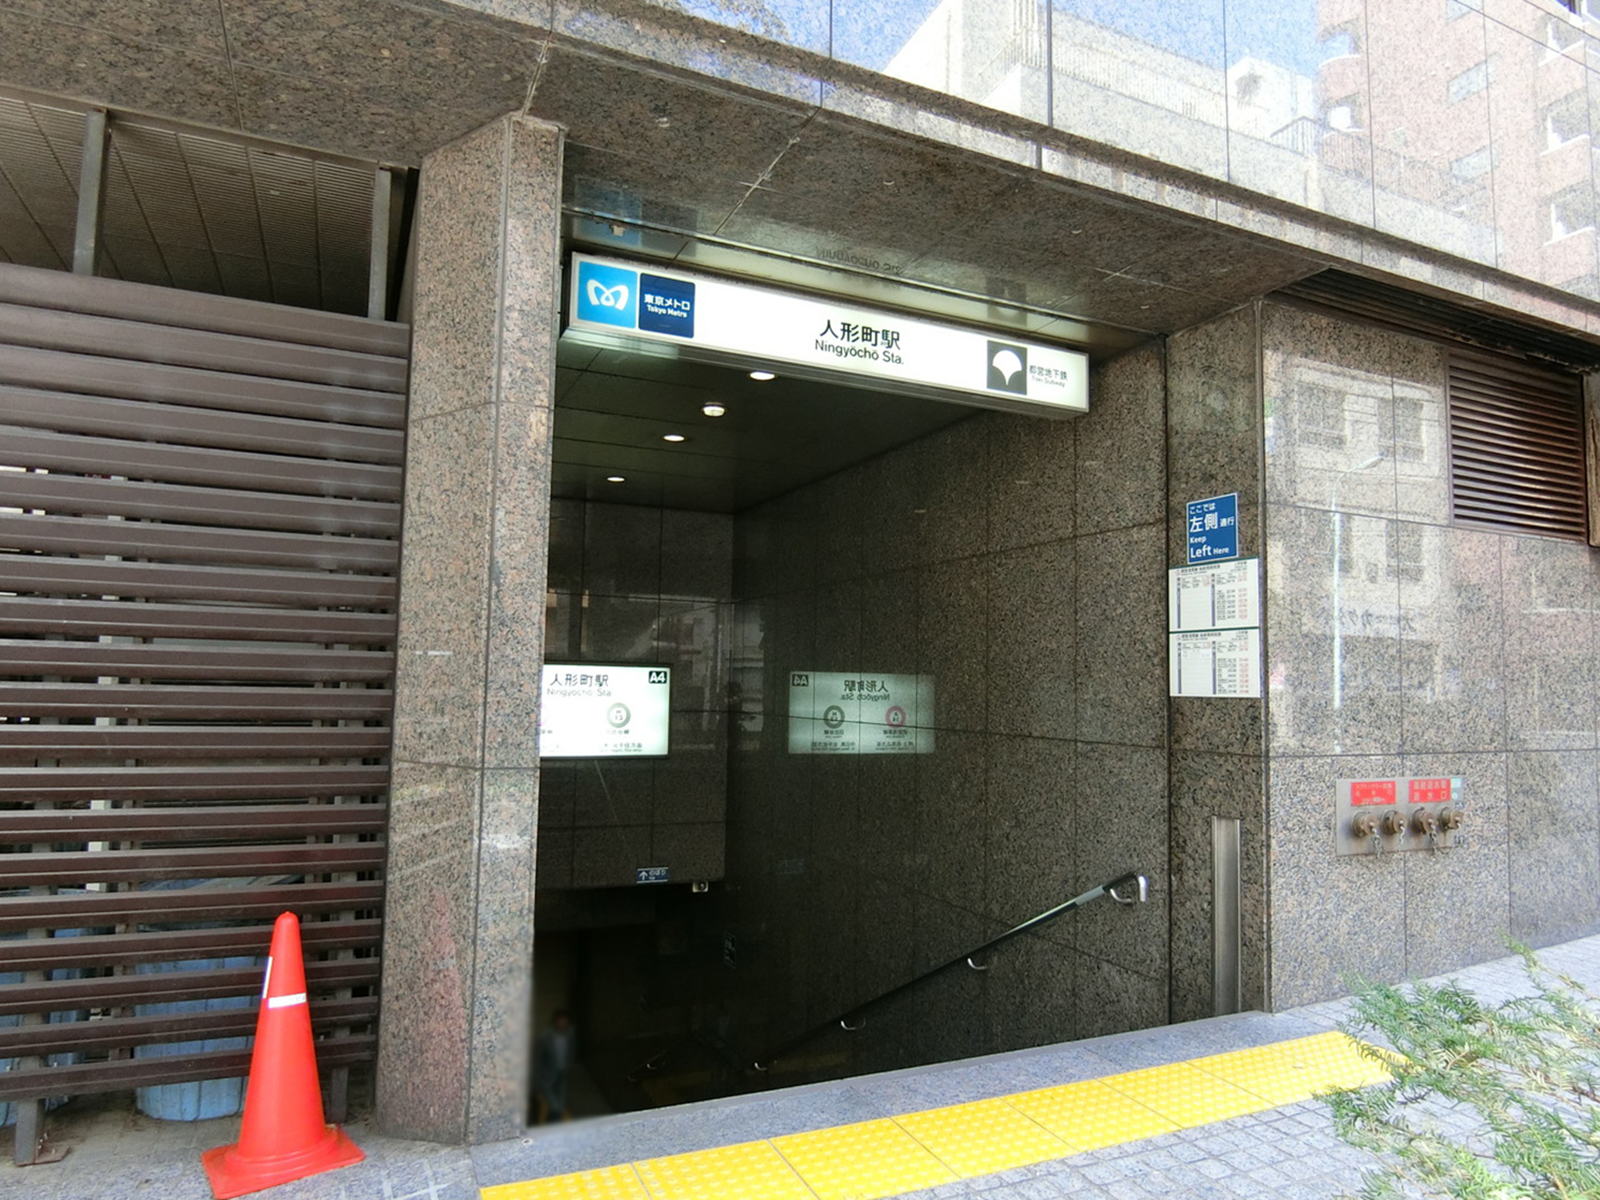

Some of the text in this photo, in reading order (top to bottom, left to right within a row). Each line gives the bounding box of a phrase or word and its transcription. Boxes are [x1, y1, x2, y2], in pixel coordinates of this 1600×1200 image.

[644, 293, 691, 311] 東京メトロ
[647, 304, 688, 318] Tokyo Metro
[819, 318, 901, 351] 人形町駅
[815, 339, 905, 365] Ningyōchō Sta.
[1029, 364, 1068, 381] 都営地下鉄
[1190, 502, 1216, 515] ここでは
[1190, 536, 1207, 544] Keep
[1190, 544, 1230, 558] Left Here
[549, 673, 609, 688] 人形町駅
[650, 672, 667, 683] A4
